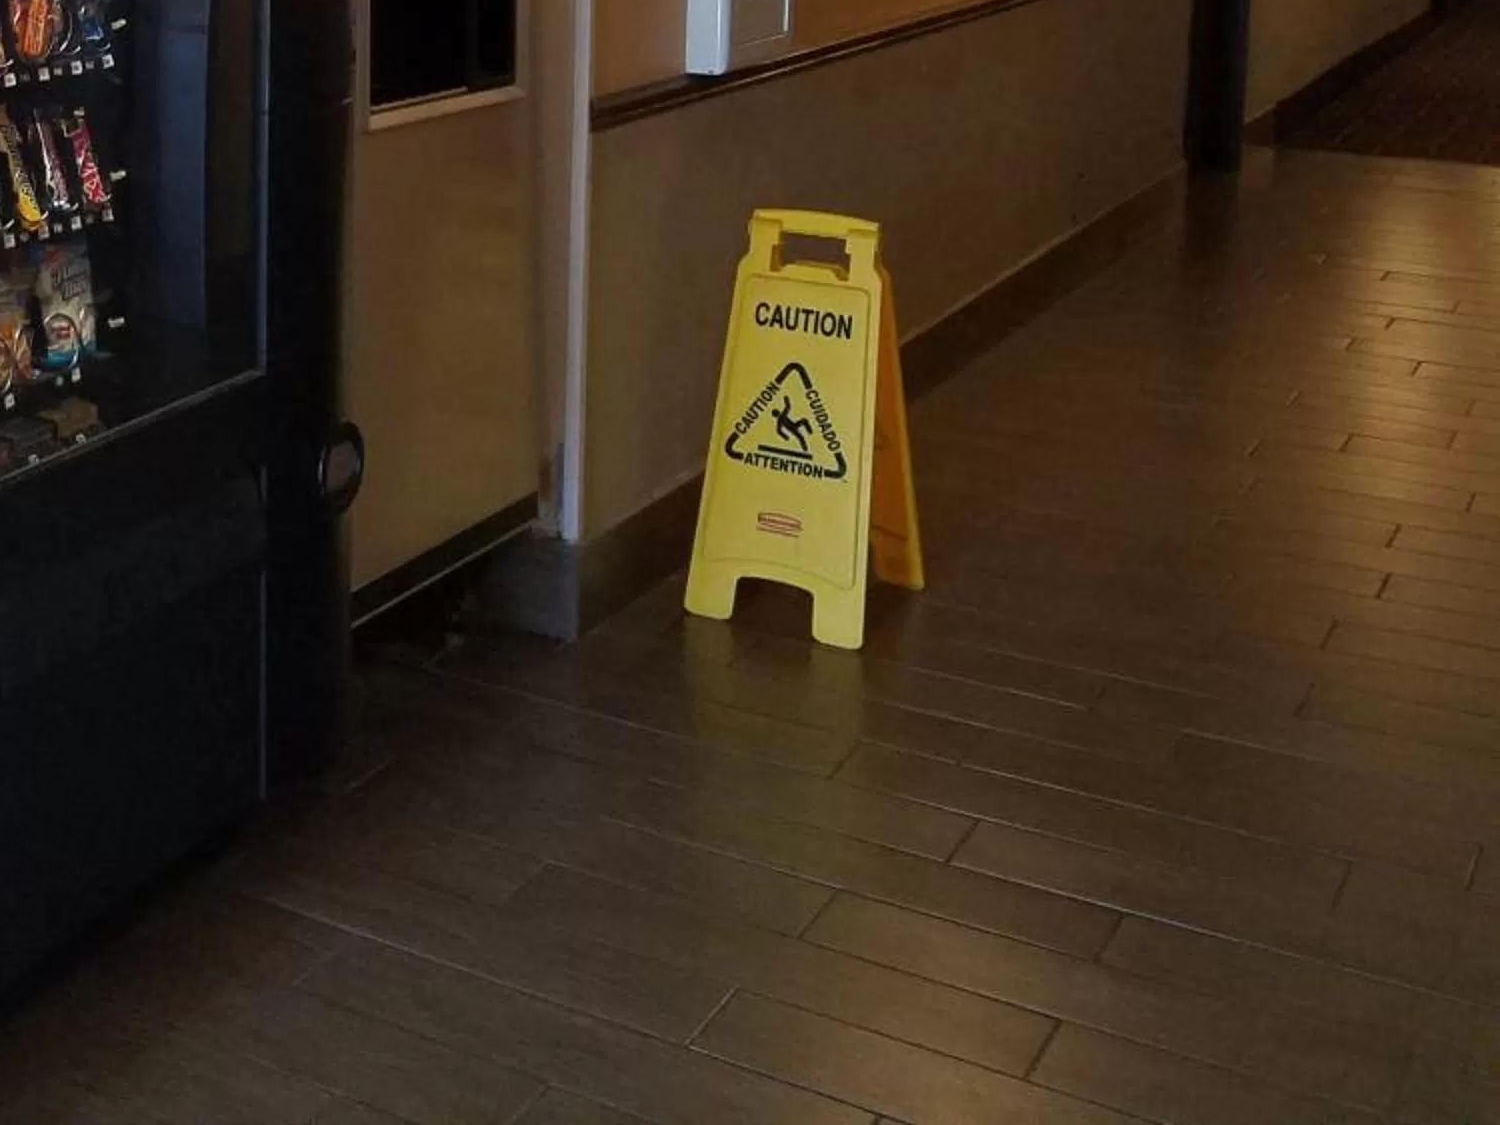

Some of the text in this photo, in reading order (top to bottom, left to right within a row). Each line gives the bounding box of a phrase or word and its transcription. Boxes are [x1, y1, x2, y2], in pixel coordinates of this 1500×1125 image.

[754, 301, 853, 340] CAUTION
[735, 381, 780, 437] CAUTION
[805, 389, 840, 452] CUIDADO
[743, 454, 824, 480] ATTENTION
